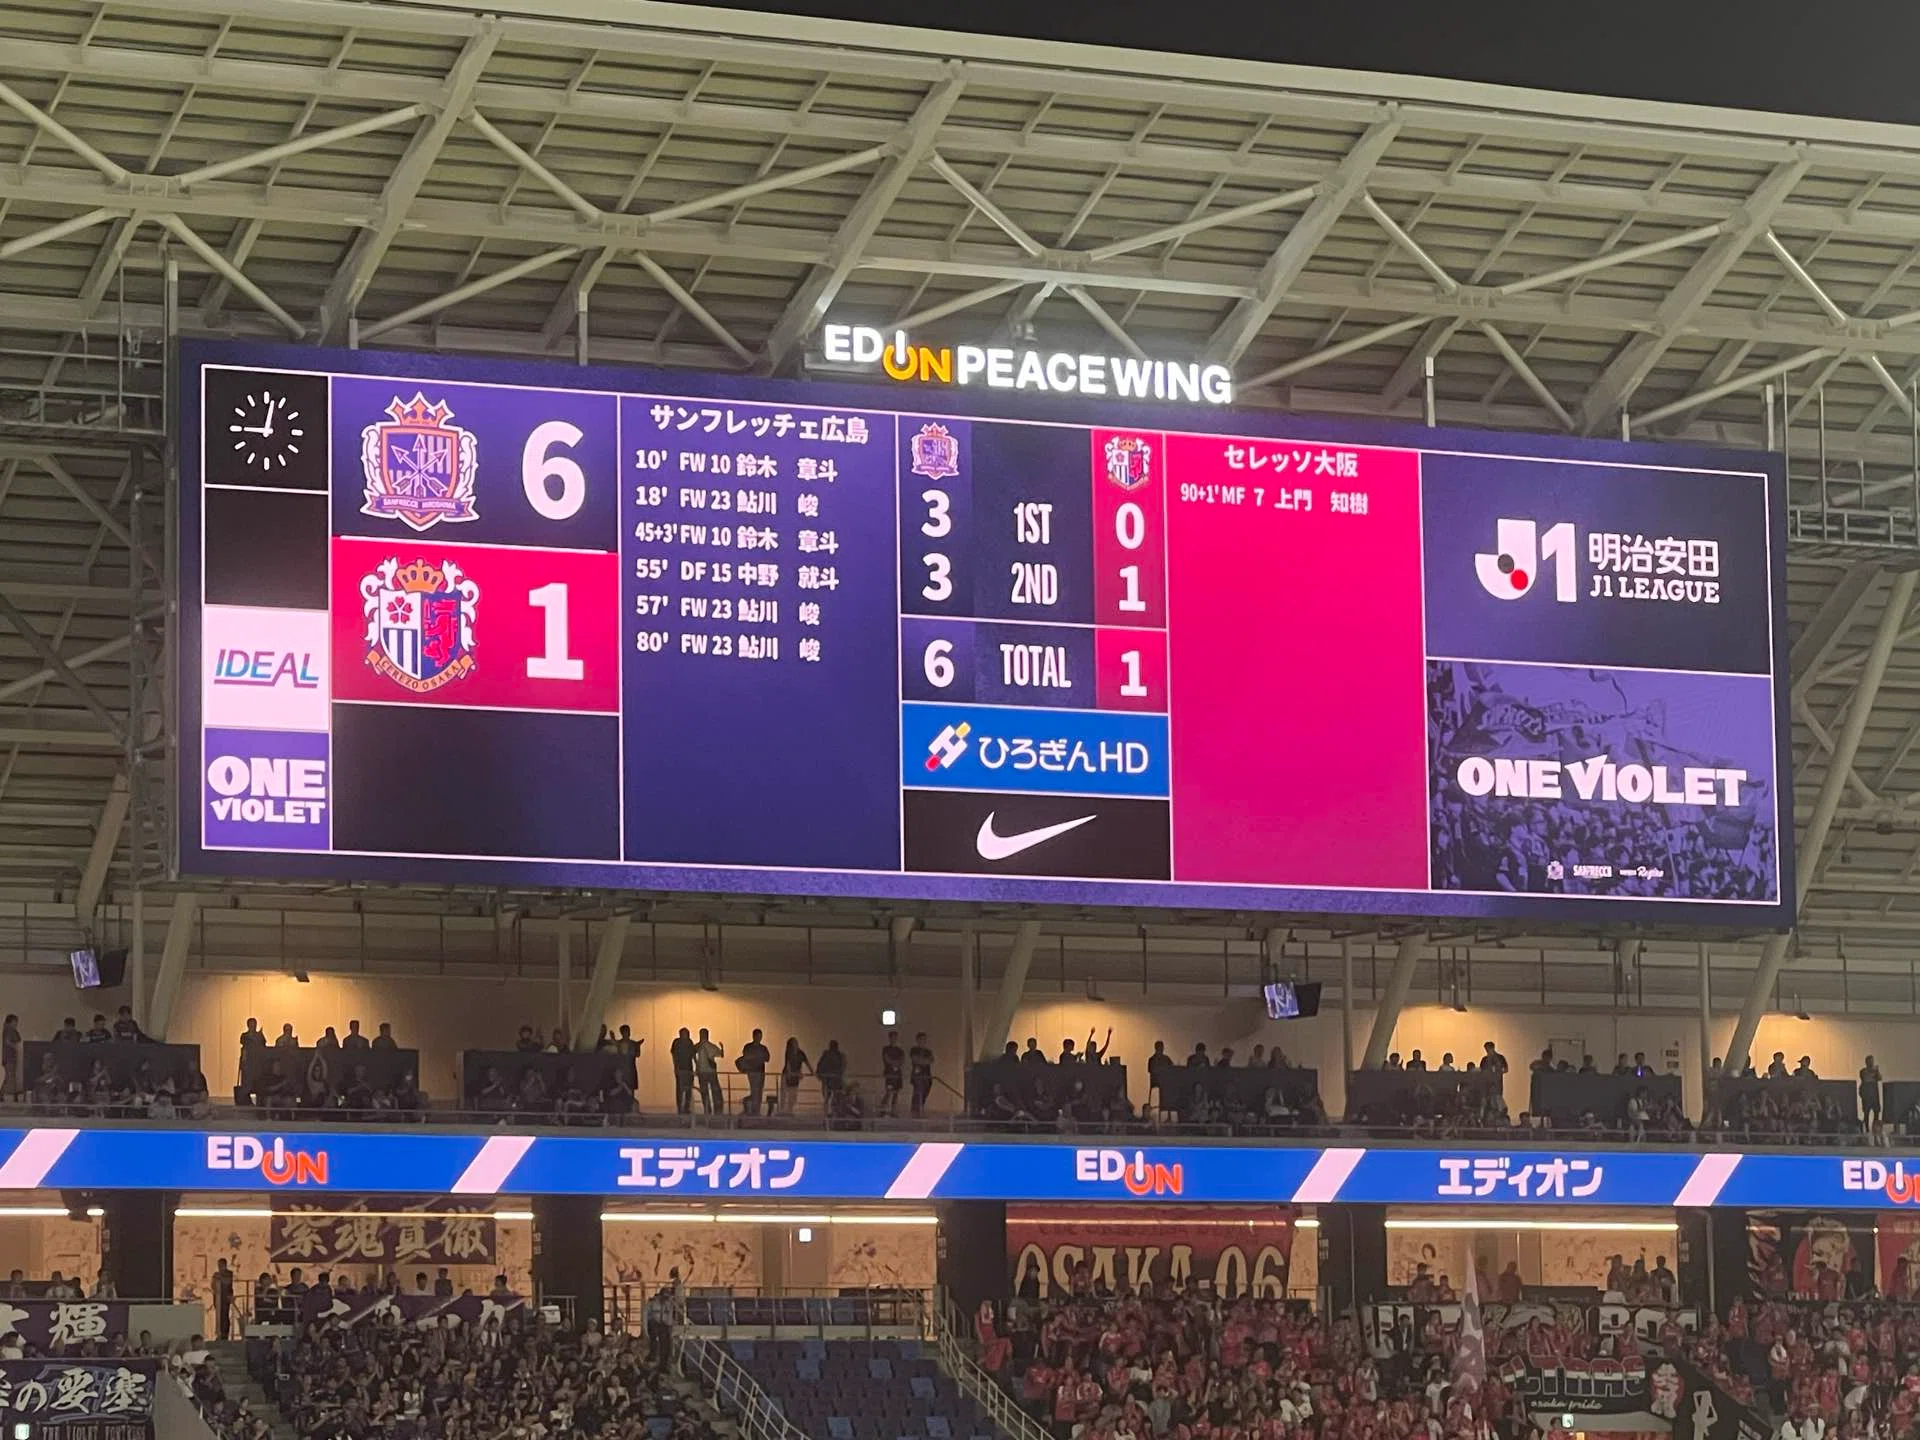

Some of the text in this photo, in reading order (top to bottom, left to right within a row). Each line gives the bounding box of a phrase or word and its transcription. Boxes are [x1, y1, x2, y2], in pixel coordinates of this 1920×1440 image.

[824, 324, 1233, 403] EDION PEACE WING
[650, 404, 869, 444] サンフレッチェ広島
[522, 420, 585, 520] 6
[635, 450, 838, 482] 10' FW 10 鈴木 章斗
[1224, 444, 1358, 477] セレッソ大阪
[635, 486, 818, 517] 18' FW 23 鮎川 峻
[921, 489, 1145, 549] 3 1ST 0
[1221, 486, 1245, 505] MF
[1254, 488, 1265, 506] 7
[1274, 488, 1312, 511] 上門
[1330, 492, 1368, 515] 知樹
[680, 525, 706, 545] FW
[711, 527, 731, 546] 10
[737, 526, 778, 550] 鈴木
[798, 530, 839, 554] 章斗
[1475, 518, 1577, 602] J1
[1588, 532, 1719, 577] 明治安田
[636, 559, 839, 590] 55' DF 15 中野 就斗
[922, 553, 1146, 611] 3 2ND 1
[1590, 574, 1720, 604] J1 LEAGUE
[526, 582, 584, 680] 1
[636, 596, 819, 625] 57' FW 23 鮎川 峻
[636, 632, 820, 662] 80' FW 23 鮎川 峻
[924, 639, 1147, 696] 6 TOTAL 1
[214, 649, 319, 688] IDEAL
[380, 659, 459, 690] CEREZO OSAKA
[978, 737, 1148, 774] ひろぎんHD
[207, 755, 326, 799] ONE
[1457, 754, 1747, 807] ONE VIOLET
[210, 797, 326, 824] VIOLET
[207, 1136, 328, 1184] EDION
[617, 1147, 805, 1189] エディオン
[1075, 1149, 1184, 1196] EDION
[1438, 1157, 1603, 1198] エディオン
[1843, 1160, 1920, 1204] EDIO
